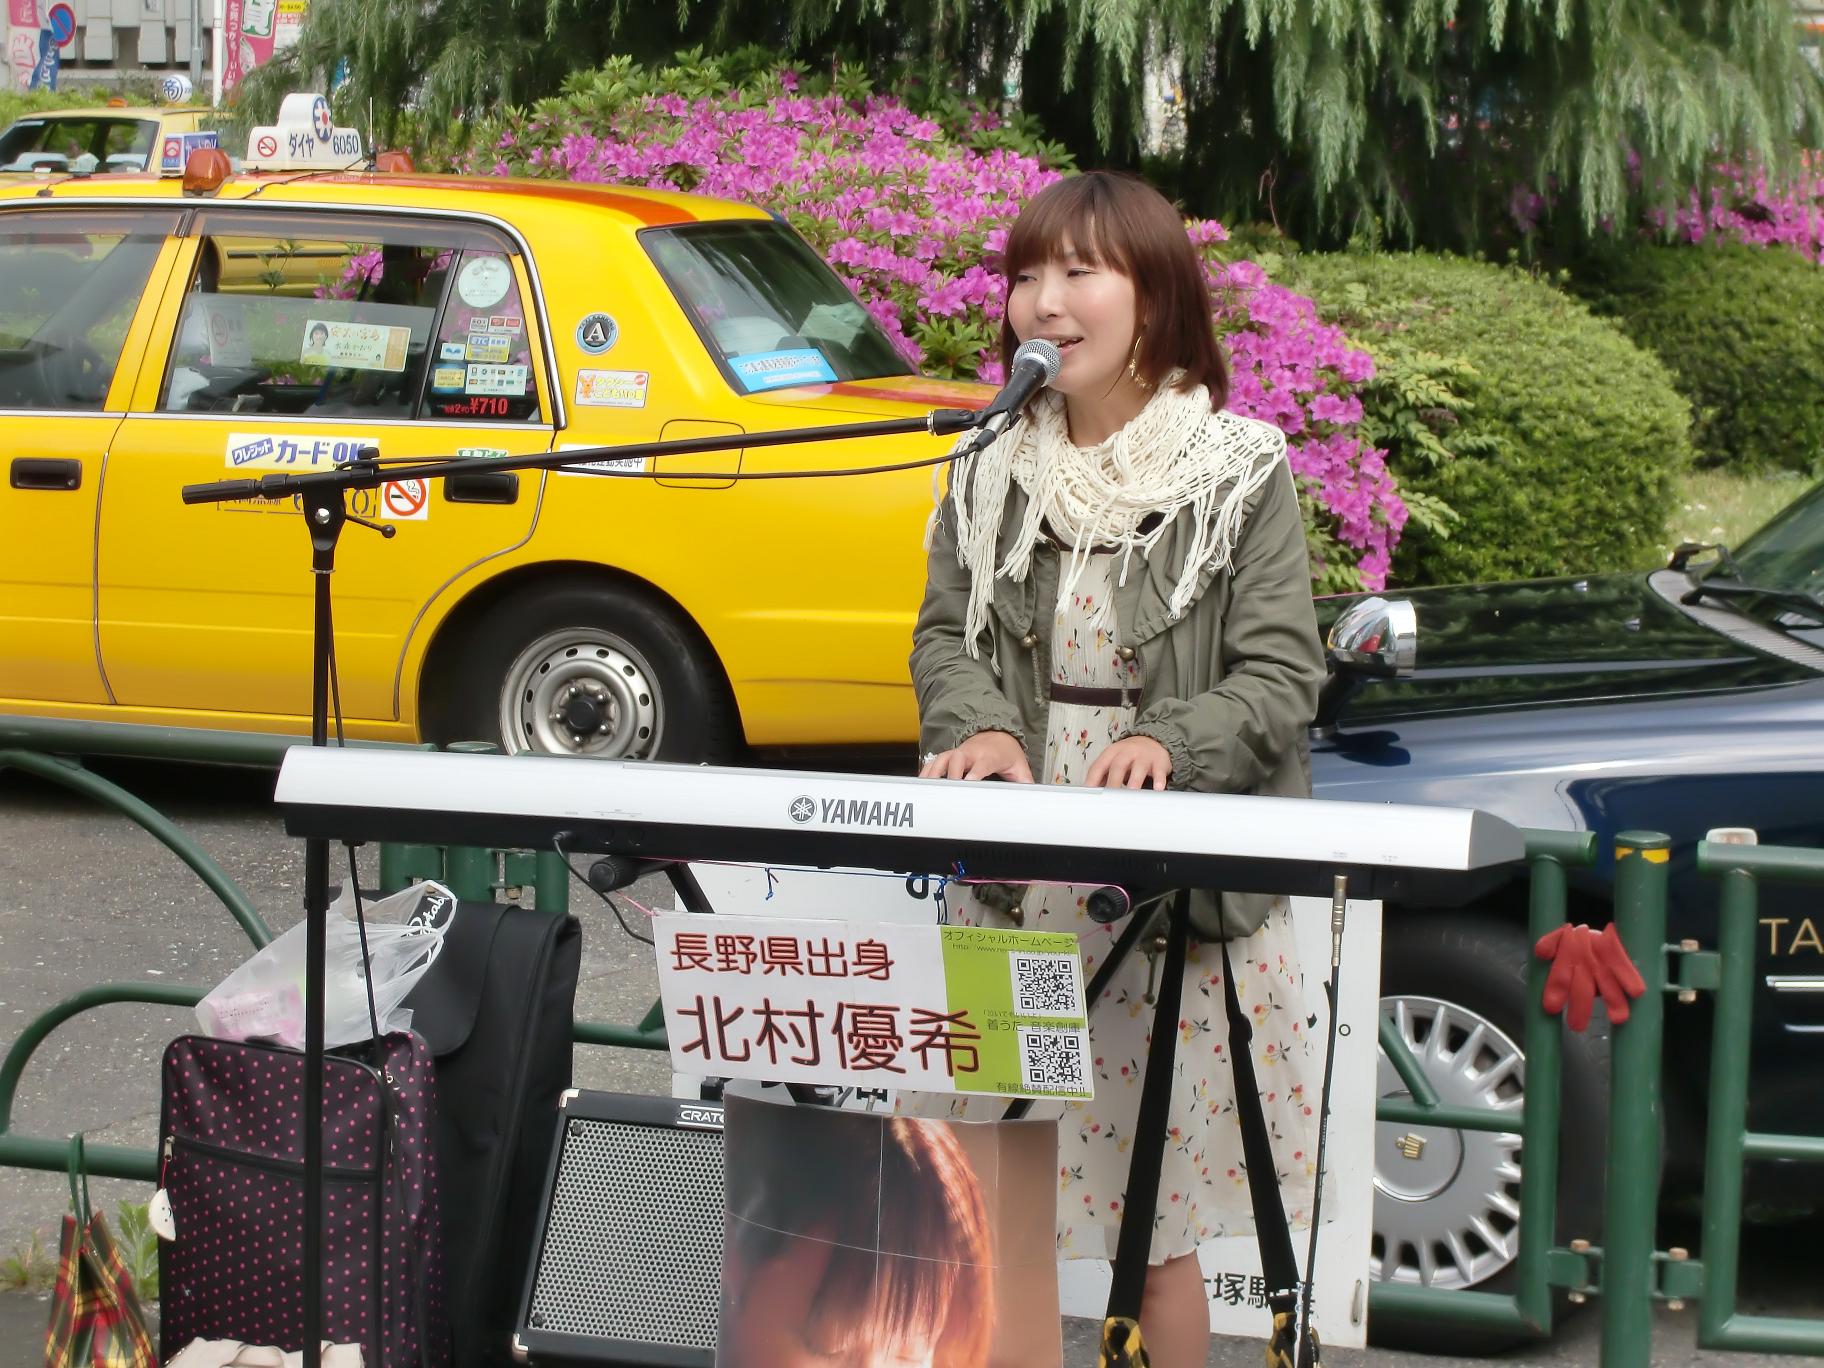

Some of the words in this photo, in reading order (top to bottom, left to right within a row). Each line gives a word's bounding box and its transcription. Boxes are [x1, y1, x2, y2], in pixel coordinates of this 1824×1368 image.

[288, 133, 315, 159] ダイヤ
[332, 134, 360, 155] 6050
[585, 322, 607, 342] A
[232, 438, 274, 465] クレジット
[821, 798, 914, 829] YAMAHA
[943, 930, 1075, 948] オフィシャルホームページ
[1758, 918, 1824, 956] TA
[669, 932, 895, 981] 長野県出身
[676, 995, 982, 1077] 北村優希
[987, 1018, 1024, 1032] 着うた
